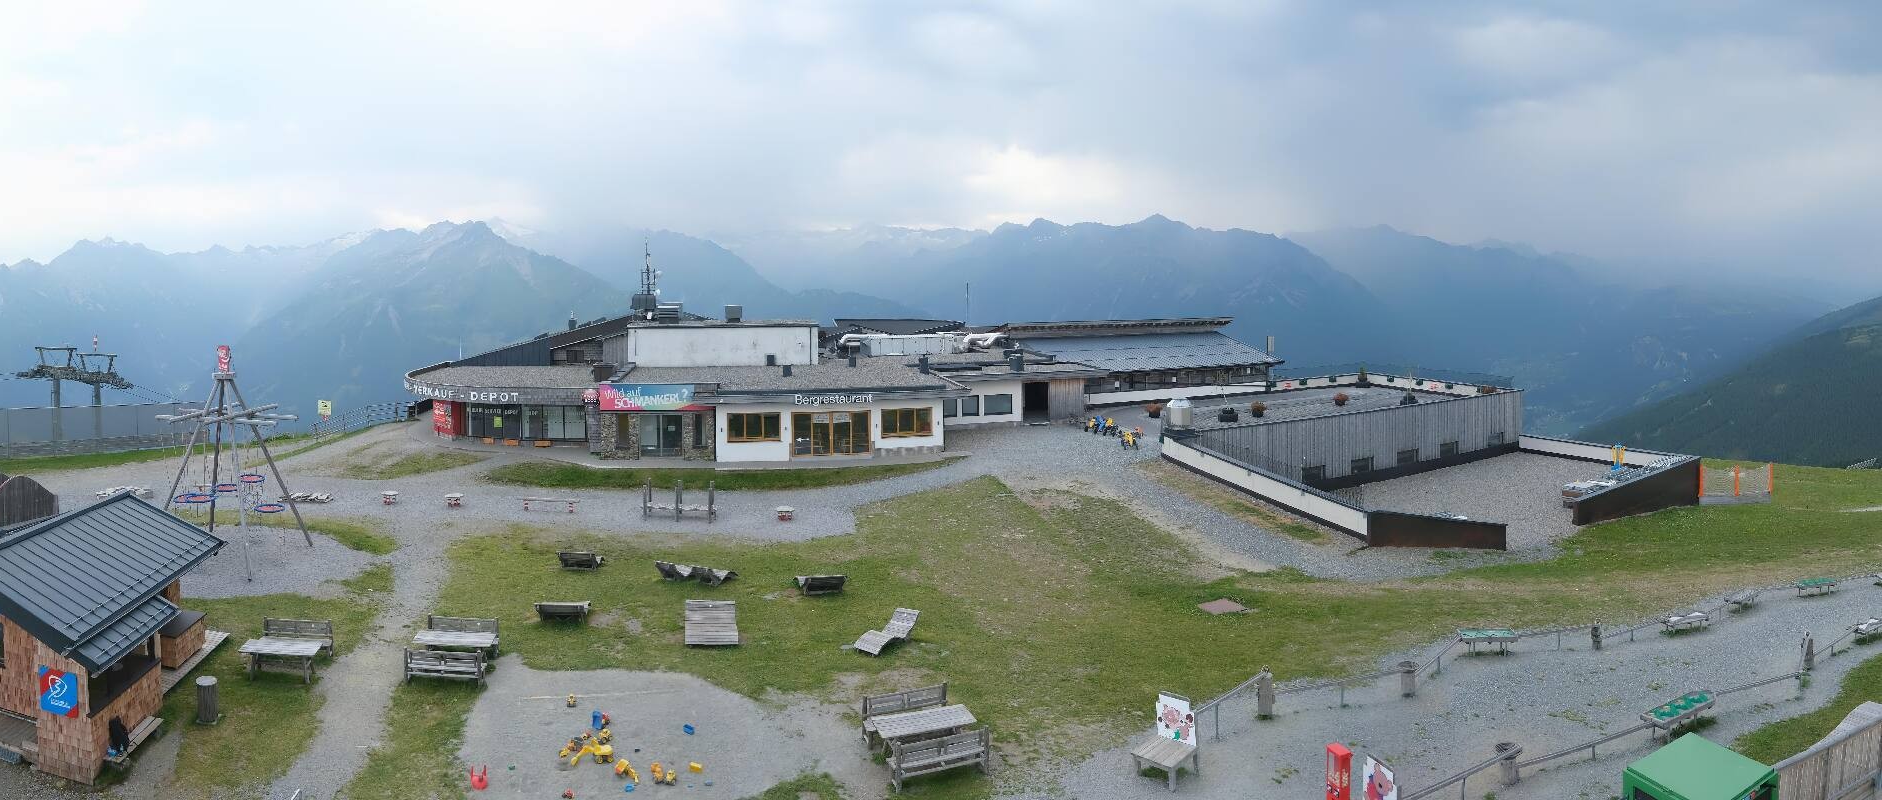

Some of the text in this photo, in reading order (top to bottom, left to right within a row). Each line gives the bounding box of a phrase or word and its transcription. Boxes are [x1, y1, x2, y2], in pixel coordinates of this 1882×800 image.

[414, 386, 455, 399] VERKAUF
[470, 391, 519, 402] DEPOT
[605, 387, 642, 399] Wild auf
[795, 394, 873, 406] Bergrestaurant
